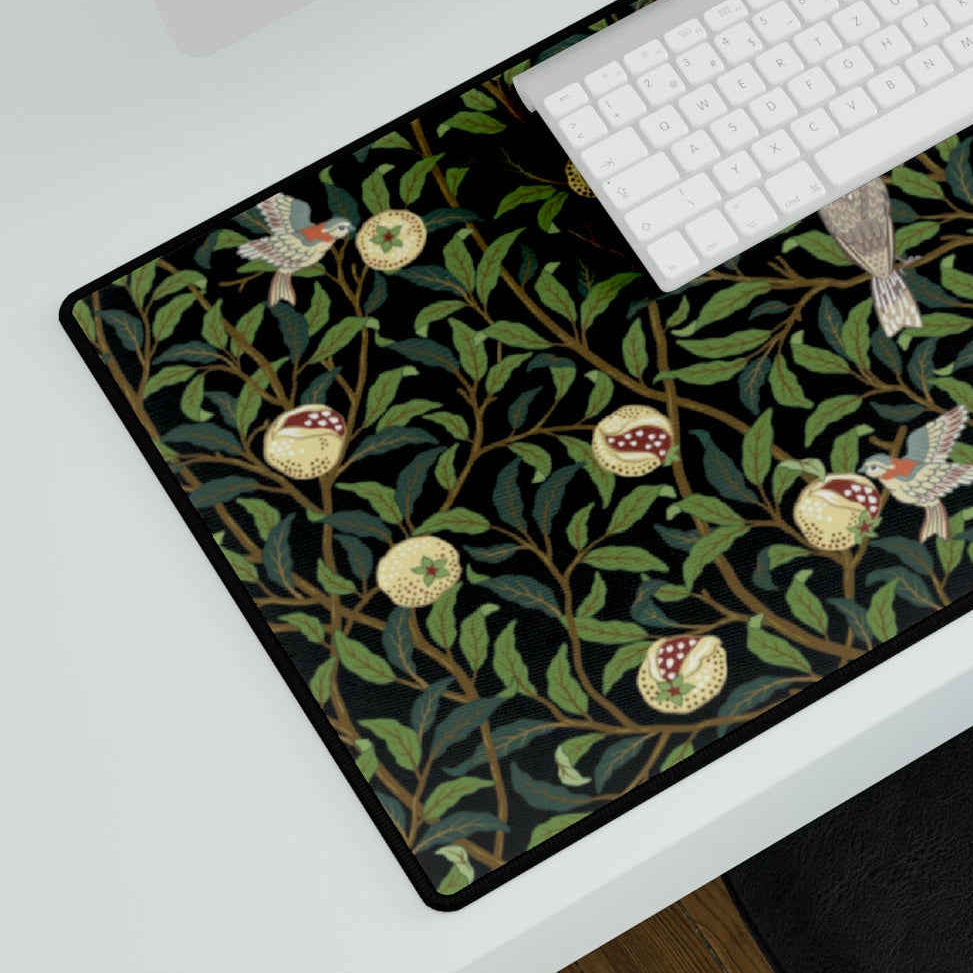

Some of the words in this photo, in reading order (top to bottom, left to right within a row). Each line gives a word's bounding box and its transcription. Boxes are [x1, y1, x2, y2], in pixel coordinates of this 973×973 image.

[658, 120, 672, 132] Q
[695, 98, 711, 112] W
[736, 78, 748, 90] E
[775, 58, 787, 68] R
[813, 36, 823, 47] T
[850, 15, 863, 27] Z
[689, 143, 701, 155] A
[727, 122, 738, 133] S
[765, 100, 777, 112] D
[804, 79, 813, 90] F
[842, 58, 854, 69] G
[880, 37, 893, 50] H
[921, 17, 929, 28] J
[729, 163, 740, 175] Y
[768, 142, 782, 155] X
[808, 121, 820, 132] C
[845, 99, 857, 111] V
[884, 79, 896, 91] B
[921, 57, 936, 70] N
[784, 195, 801, 208] cmd
